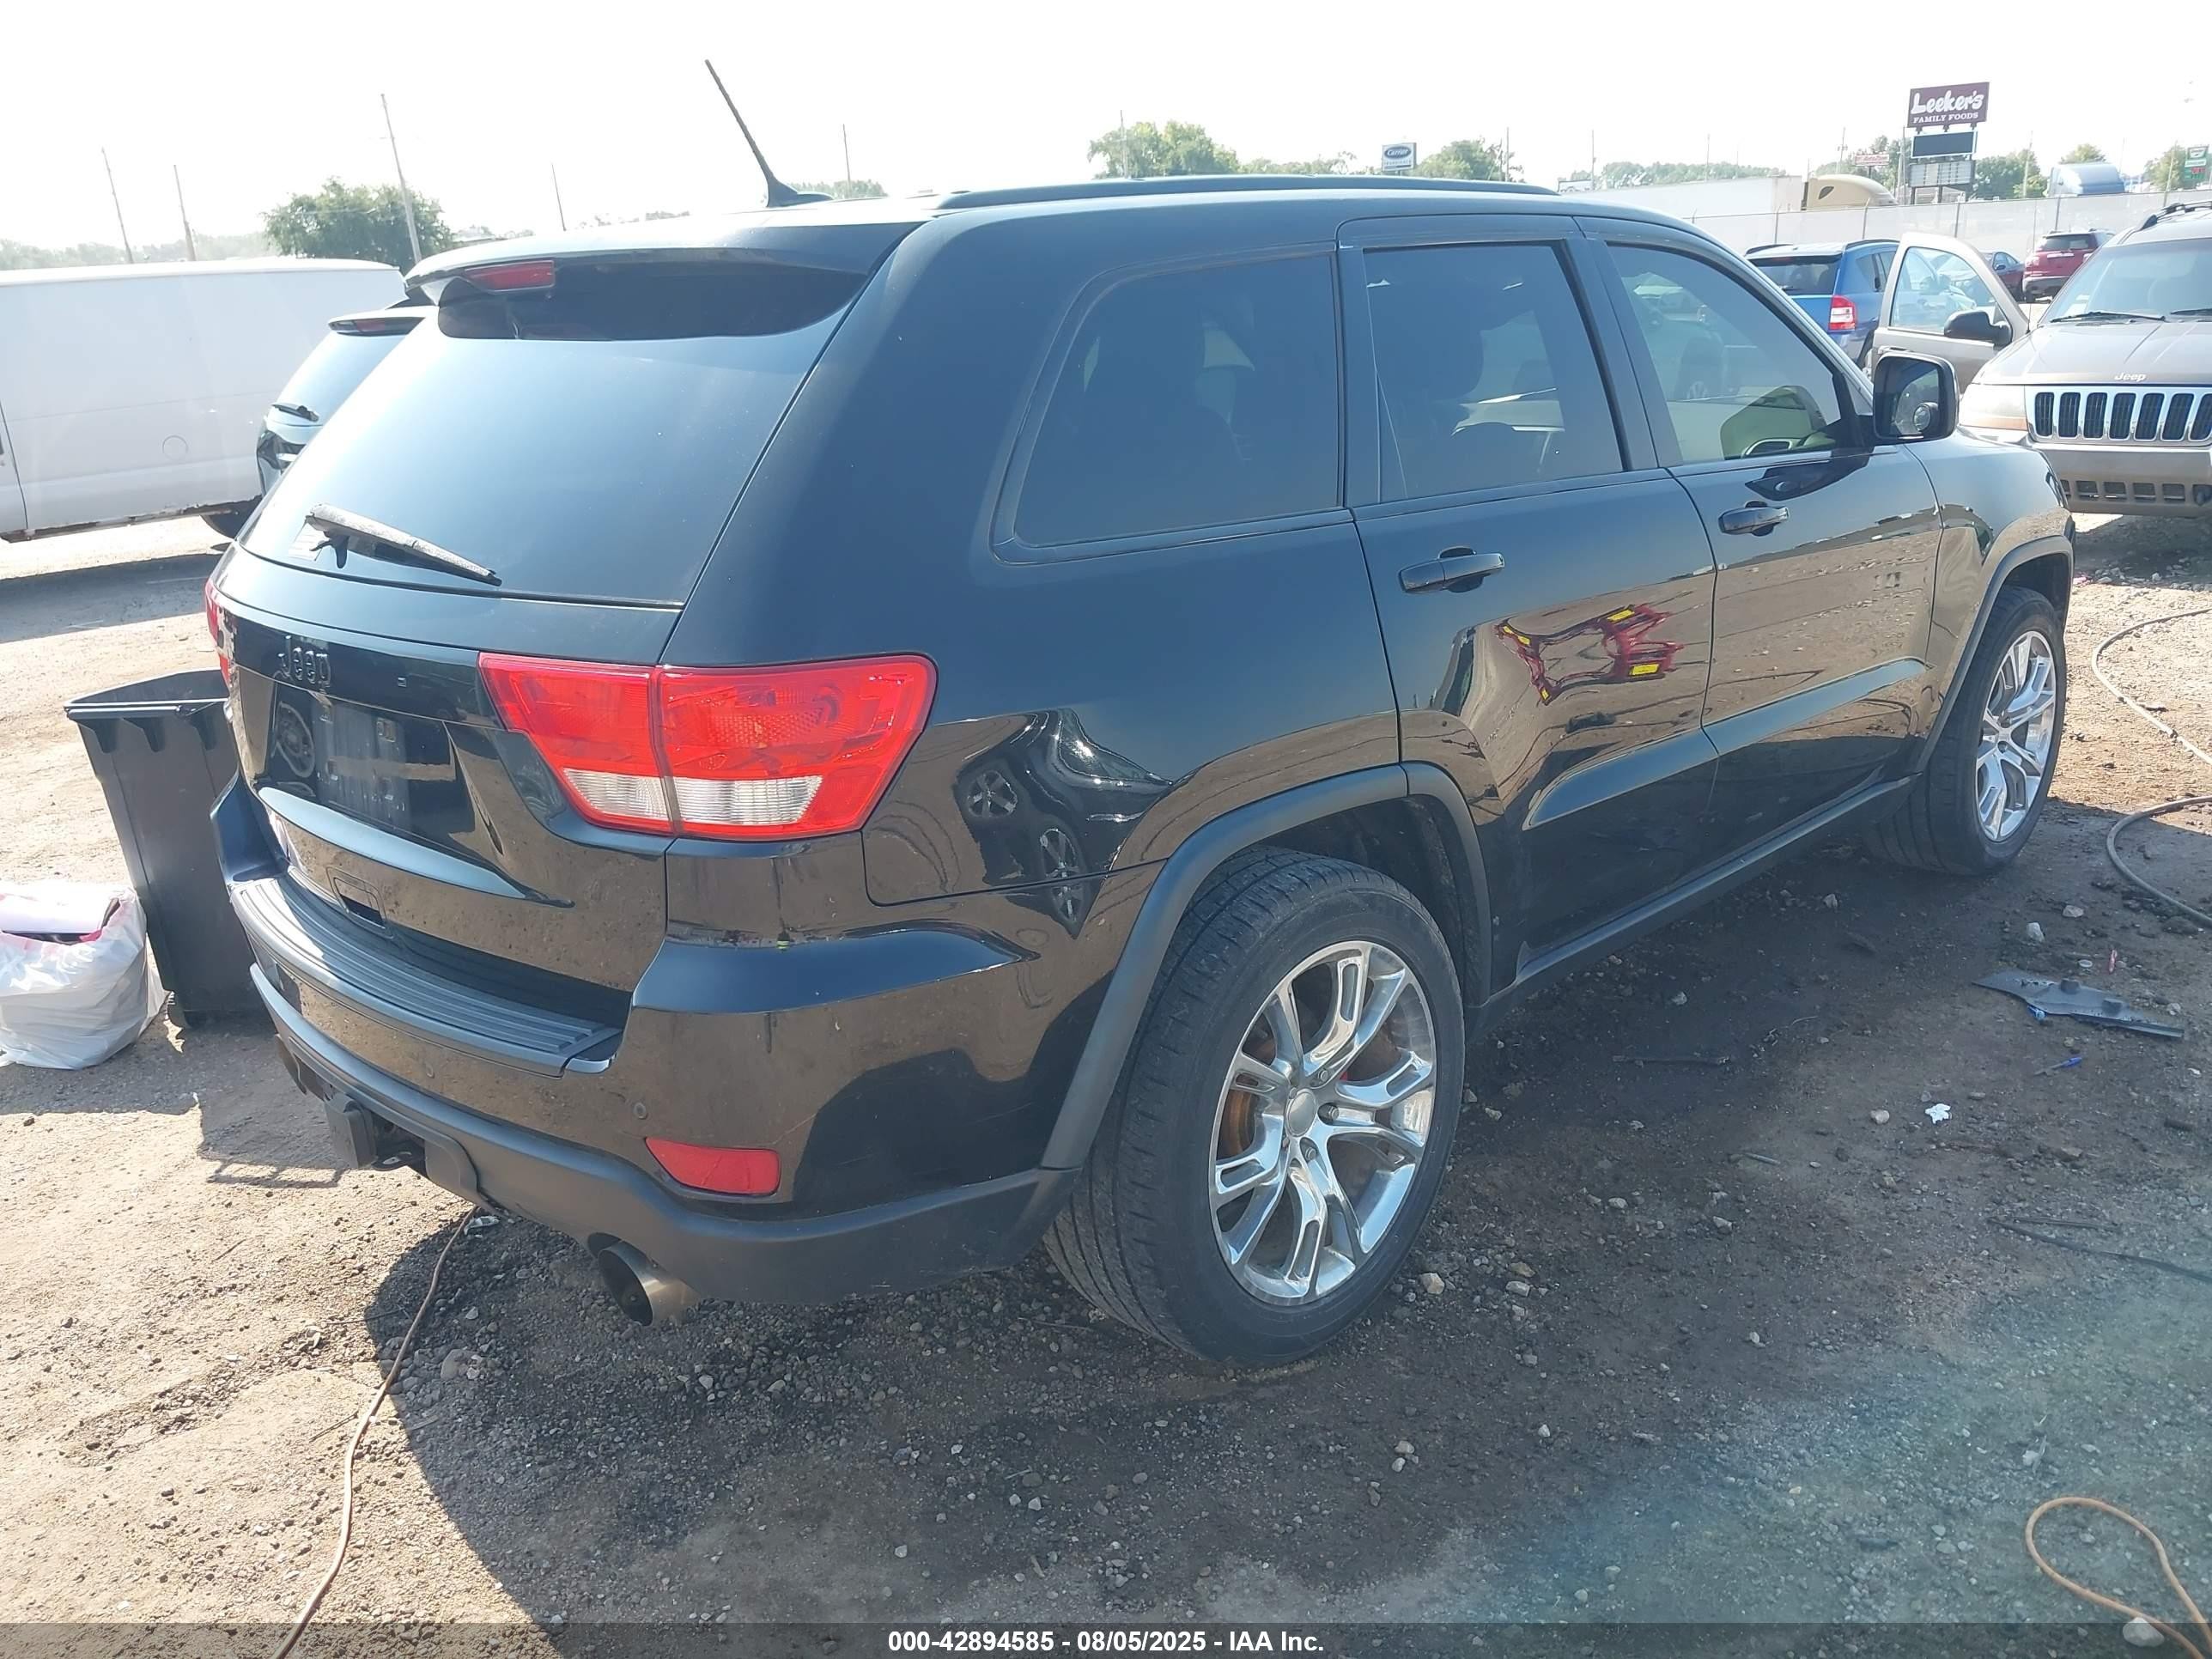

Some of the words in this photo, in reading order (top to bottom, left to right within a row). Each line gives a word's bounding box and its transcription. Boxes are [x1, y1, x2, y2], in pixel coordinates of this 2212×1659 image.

[1911, 90, 1984, 114] Leeker's
[1913, 114, 1947, 124] FAMILY
[1948, 112, 1978, 121] FOODS
[2114, 372, 2147, 382] Jeep
[277, 635, 331, 688] Jeep
